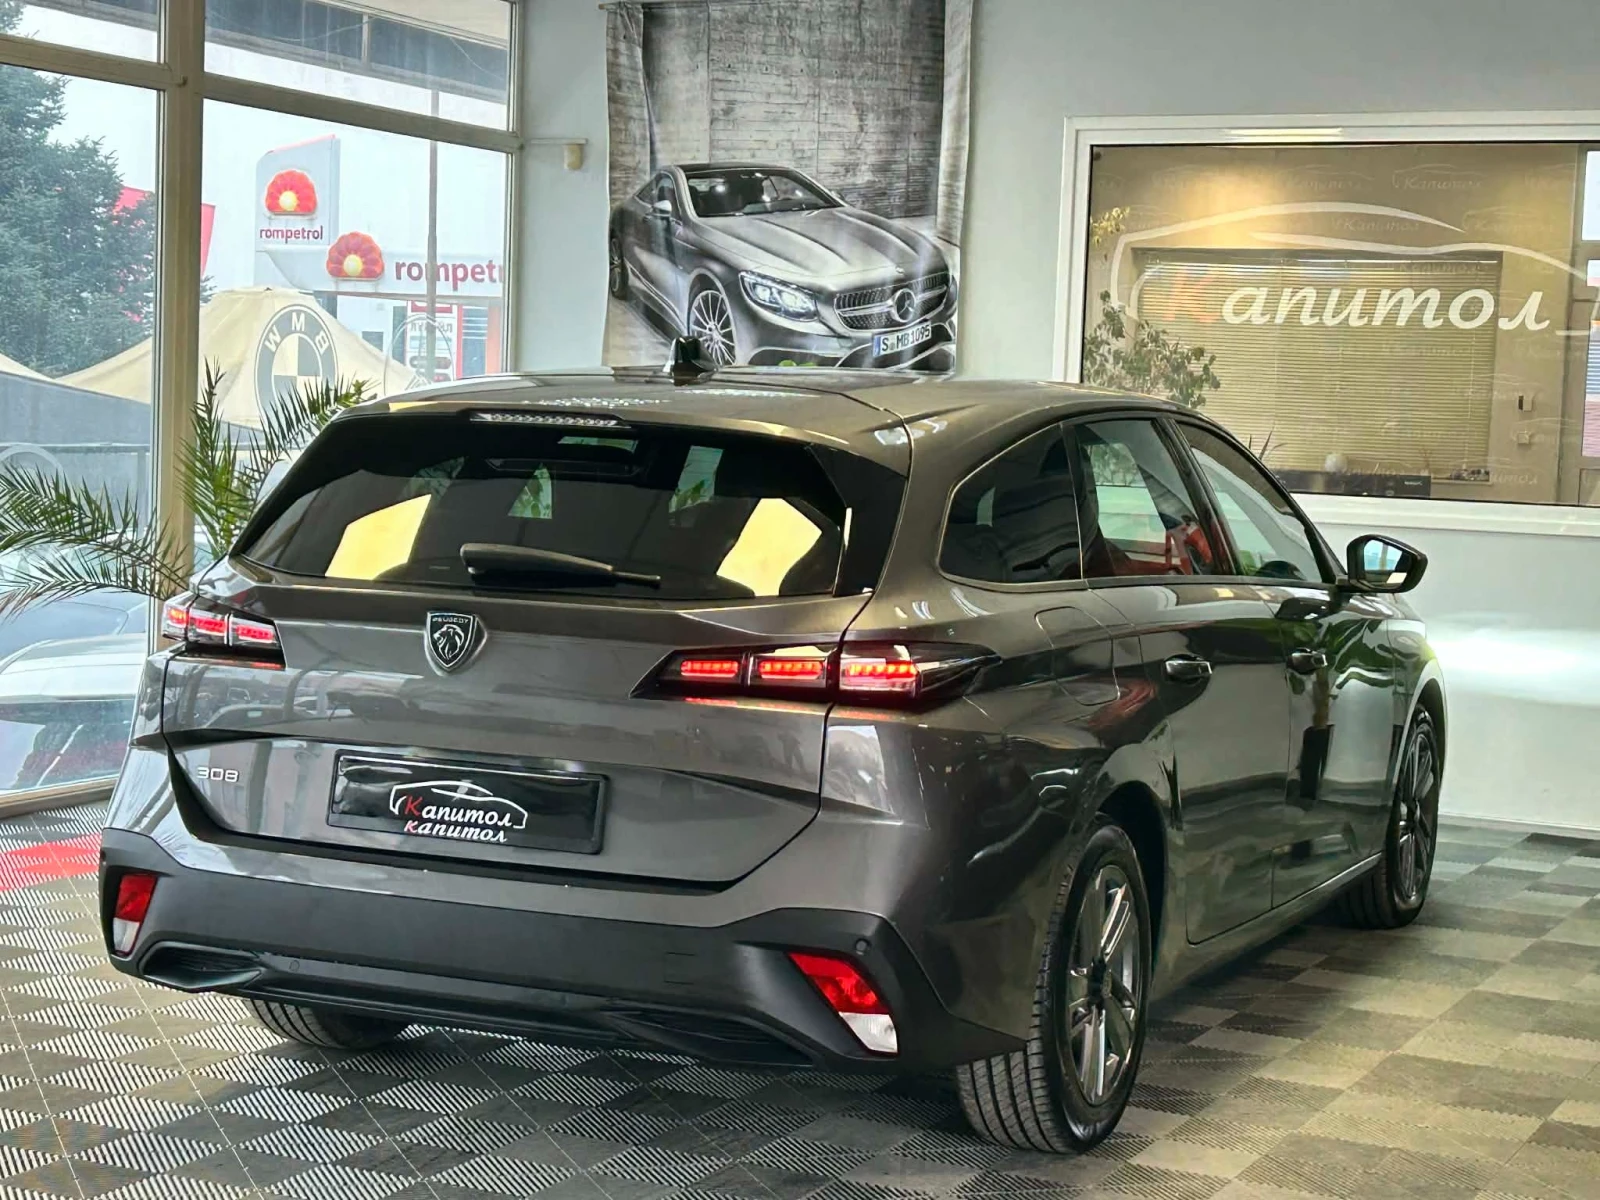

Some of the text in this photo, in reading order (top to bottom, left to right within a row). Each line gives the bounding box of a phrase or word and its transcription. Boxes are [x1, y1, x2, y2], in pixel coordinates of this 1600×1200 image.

[259, 225, 324, 244] rompetrol
[1162, 270, 1550, 331] Капитол
[432, 616, 469, 624] PEUGEOT
[196, 766, 239, 783] 308
[403, 795, 513, 827] Капитол
